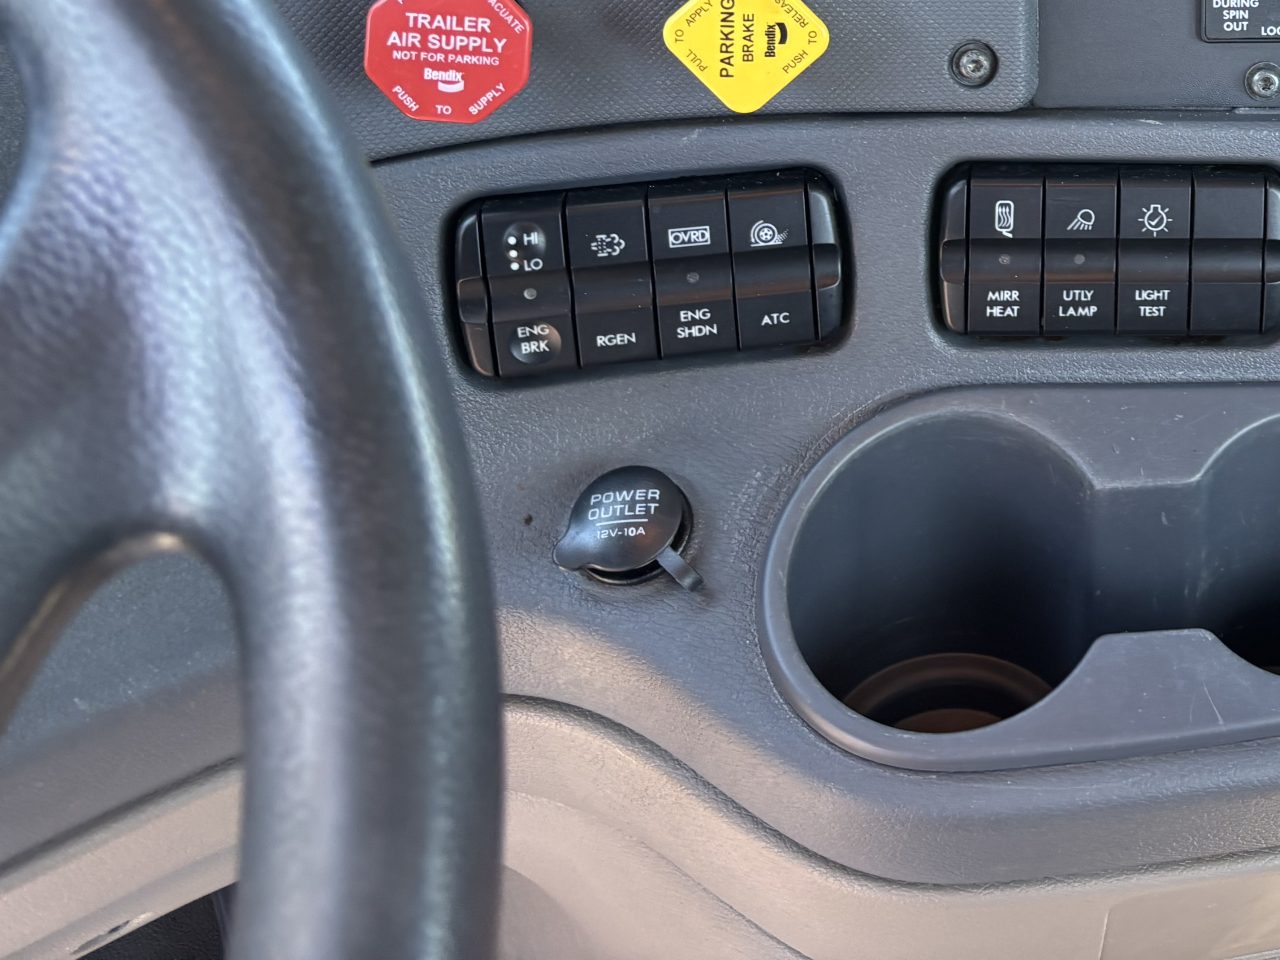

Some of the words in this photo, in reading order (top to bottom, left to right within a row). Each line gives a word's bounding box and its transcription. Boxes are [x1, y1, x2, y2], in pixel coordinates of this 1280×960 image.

[1223, 10, 1249, 19] SPIN
[405, 12, 491, 33] TRAILER
[1223, 21, 1249, 31] OUT
[386, 31, 422, 48] AIR
[427, 33, 507, 53] SUPPLY
[675, 28, 684, 44] TO
[742, 13, 755, 62] BRAKE
[764, 24, 777, 58] Bendix
[392, 50, 418, 61] NOT
[420, 51, 445, 62] FOR
[448, 54, 500, 66] PARKING
[782, 49, 809, 74] PUSH
[807, 30, 818, 45] TO
[686, 48, 709, 72] PULL
[423, 67, 463, 82] Bendix
[392, 85, 419, 112] PUSH
[435, 104, 452, 115] TO
[468, 82, 506, 115] SUPPLY
[523, 232, 538, 245] HI
[670, 230, 708, 244] OVRD
[524, 258, 543, 271] LO
[987, 290, 1020, 302] MIRR
[1063, 290, 1094, 301] UTLY
[1135, 290, 1170, 301] LIGHT
[679, 308, 711, 322] ENG
[986, 306, 1020, 317] HEAT
[1058, 306, 1098, 317] LAMP
[1138, 306, 1166, 317] TEST
[761, 312, 790, 326] ATC
[517, 324, 549, 338] ENG
[677, 324, 718, 339] SHDN
[521, 340, 549, 354] BRK
[596, 333, 636, 347] RGEN
[590, 489, 660, 505] POWER
[588, 503, 660, 520] OUTLET
[597, 526, 646, 539] 12V-10A
